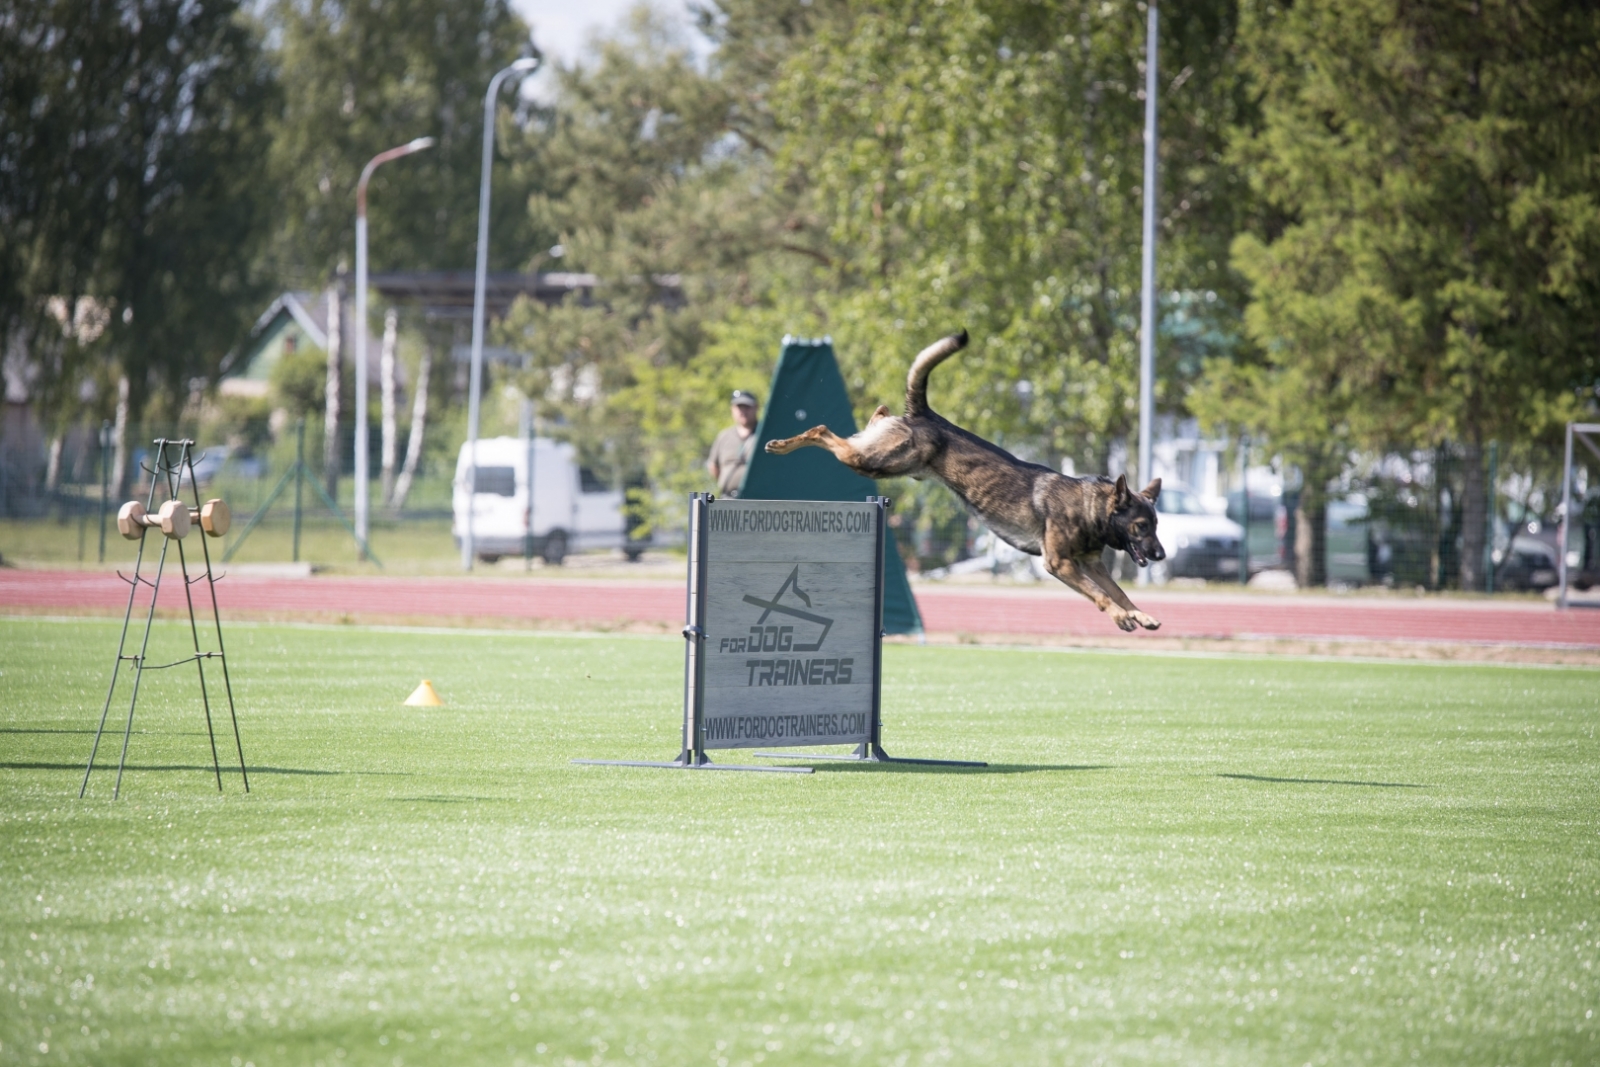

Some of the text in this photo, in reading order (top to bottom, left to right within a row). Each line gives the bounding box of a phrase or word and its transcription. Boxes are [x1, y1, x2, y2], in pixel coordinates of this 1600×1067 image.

[710, 510, 870, 533] WWW.FORDOGTRAINERS.COM
[719, 626, 794, 653] FOR DOG
[746, 658, 854, 686] TRAINERS
[705, 713, 865, 740] WWW.FORDOGTRAINERS.COM
